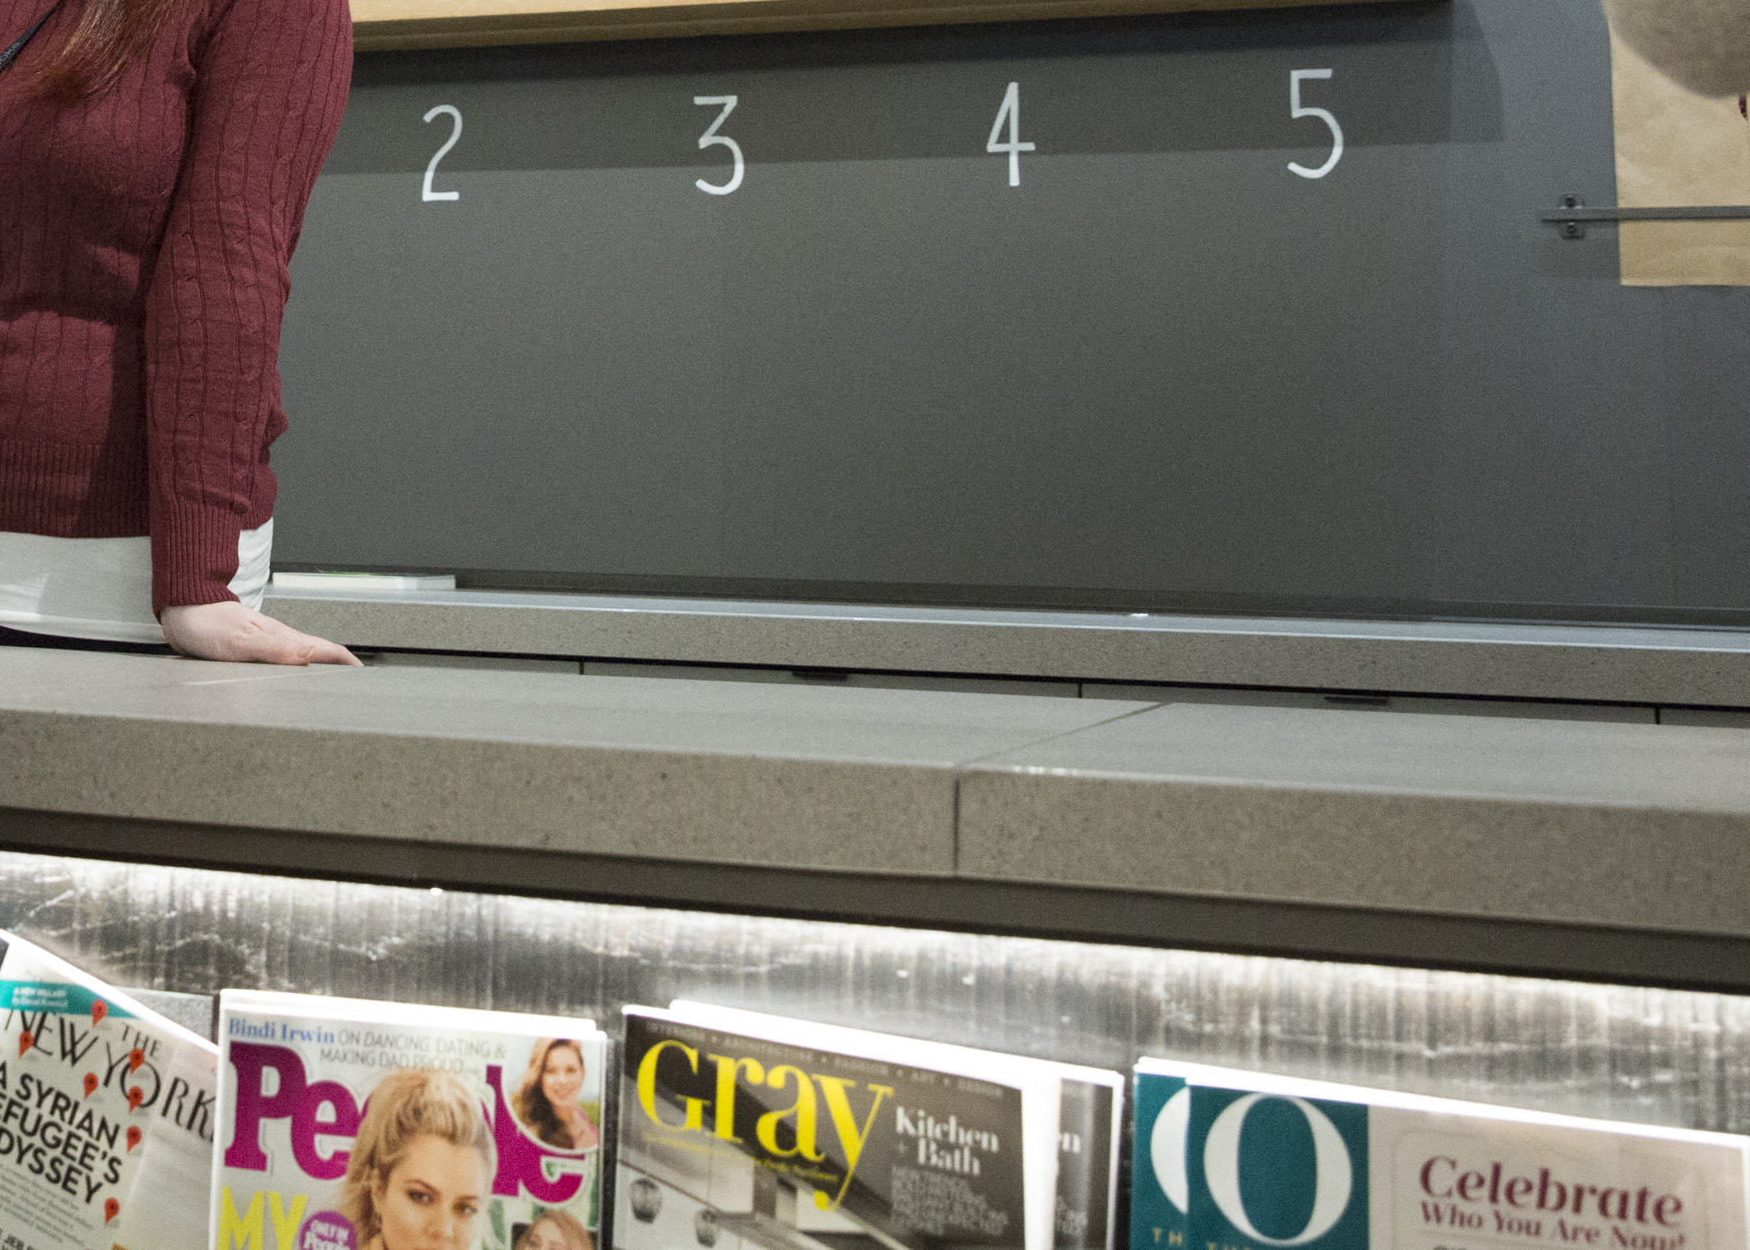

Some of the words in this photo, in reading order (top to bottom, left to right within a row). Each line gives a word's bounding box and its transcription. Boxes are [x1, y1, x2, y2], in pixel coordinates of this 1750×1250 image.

[421, 104, 464, 202] 2
[693, 95, 745, 196] 3
[986, 81, 1036, 186] 4
[1287, 68, 1344, 179] 5
[4, 1010, 99, 1067] NEW
[121, 1022, 162, 1058] THE
[229, 1017, 276, 1039] Bindi
[280, 1023, 335, 1044] Irwin
[337, 1029, 362, 1046] ON
[435, 1037, 490, 1058] DATING
[320, 1048, 376, 1068] MAKING
[379, 1051, 410, 1069] DAD
[14, 1072, 121, 1150] SYRIAN
[224, 1040, 585, 1204] Pele
[636, 1040, 894, 1212] Gray
[896, 1106, 1000, 1153] Kitchen
[918, 1137, 980, 1176] Bath
[1419, 1154, 1683, 1228] Celebrate
[217, 1185, 308, 1250] MY
[1420, 1201, 1484, 1229] Who
[1493, 1209, 1542, 1237] You
[1557, 1218, 1601, 1244] Are
